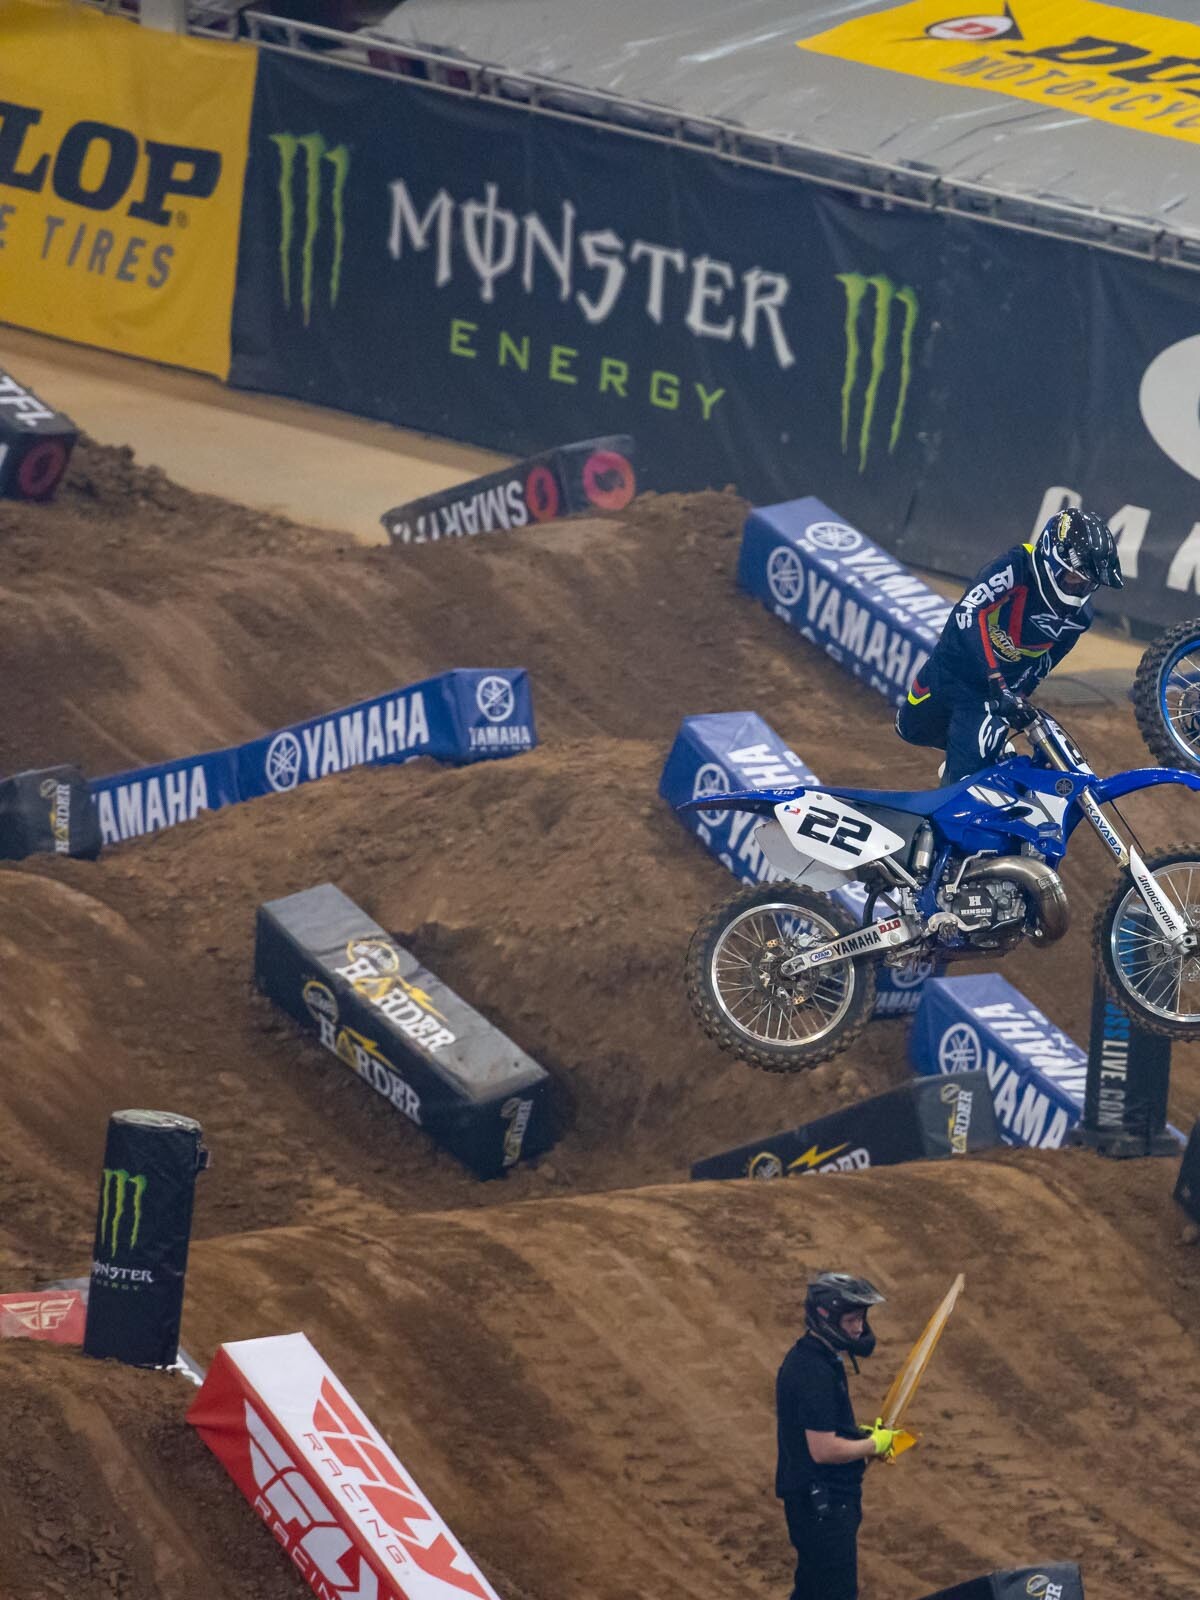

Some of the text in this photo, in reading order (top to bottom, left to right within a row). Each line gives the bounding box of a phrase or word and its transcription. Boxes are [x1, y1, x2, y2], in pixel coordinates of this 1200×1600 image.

[40, 211, 176, 290] TIRES
[387, 178, 796, 369] MONSTER
[450, 319, 725, 420] ENERGY
[840, 546, 955, 635] YAMAH
[303, 691, 430, 777] YAMAHA
[468, 725, 531, 746] YAMAHA
[91, 764, 208, 846] AMAHA
[797, 805, 872, 857] 22
[1086, 803, 1123, 857] KAYABA
[833, 929, 882, 956] YAMAHA
[960, 907, 993, 917] HINSON
[1137, 874, 1178, 932] BRIDGESTONE
[813, 950, 832, 961] AFAM
[334, 957, 457, 1054] HARDER
[319, 1015, 423, 1126] HARDER
[93, 1259, 154, 1284] ONSTER
[303, 1432, 407, 1565] RACING
